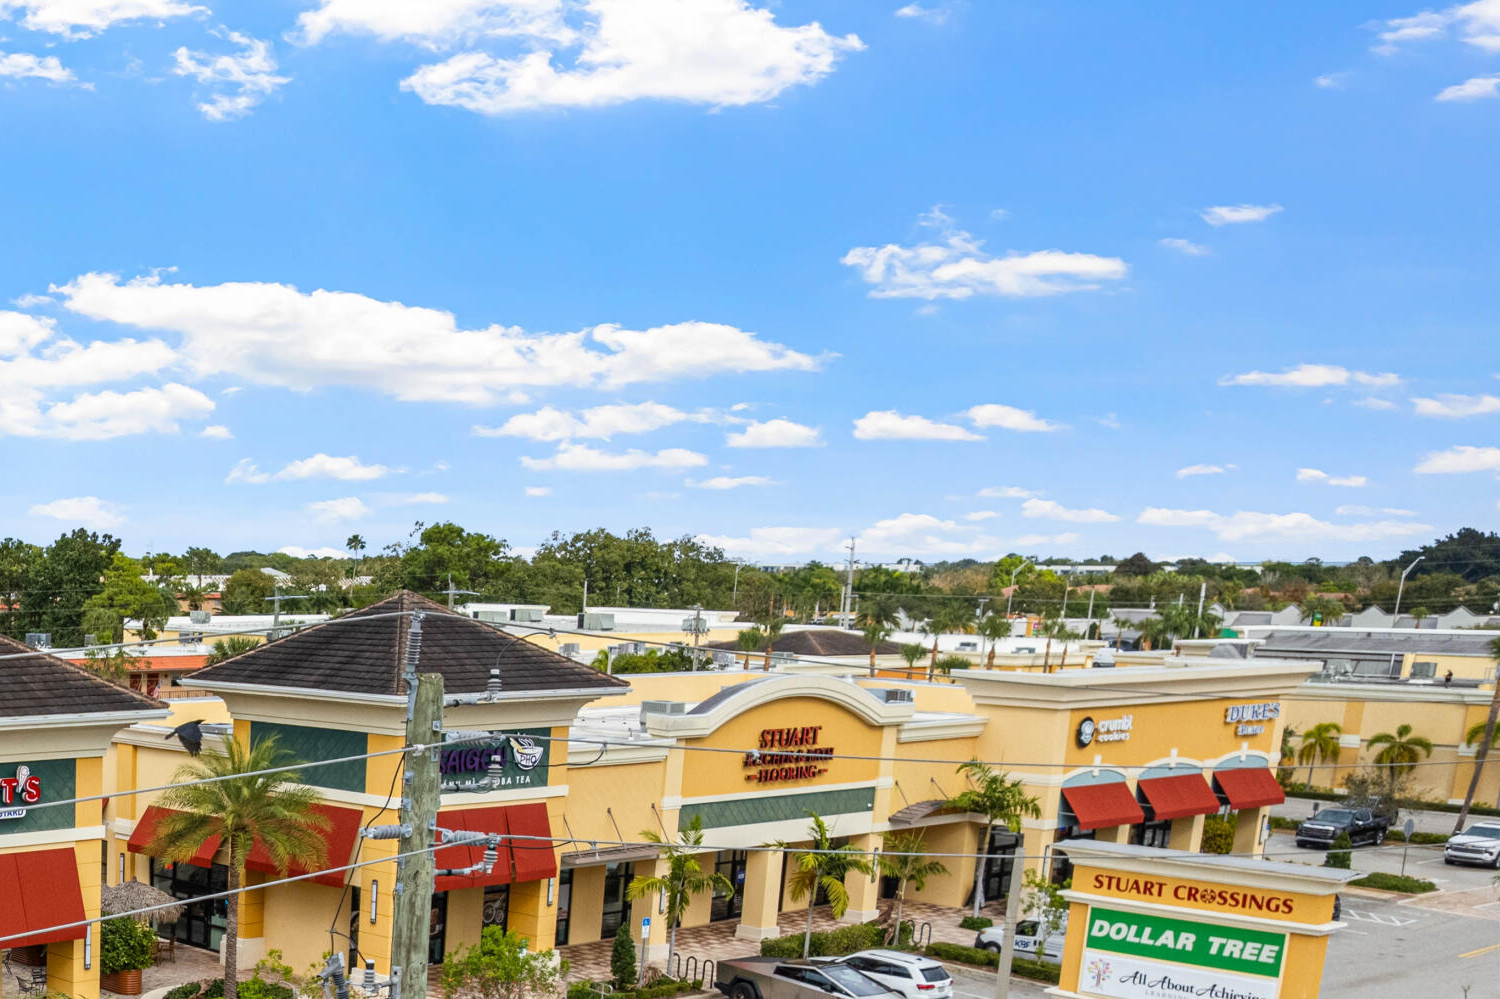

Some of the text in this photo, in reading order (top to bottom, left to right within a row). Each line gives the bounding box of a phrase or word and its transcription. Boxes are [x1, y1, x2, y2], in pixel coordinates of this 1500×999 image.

[1226, 702, 1280, 723] DUKE'S
[1098, 715, 1132, 732] crumbl
[759, 726, 822, 748] STUART
[1098, 731, 1130, 742] cookies
[520, 754, 536, 764] PHO
[516, 775, 531, 784] TEA
[758, 765, 817, 782] FLOORING
[1094, 874, 1294, 915] STUART CROSSINGS
[1090, 919, 1280, 964] DOLLAR TREE
[1119, 971, 1146, 985] All
[1148, 976, 1195, 993] About
